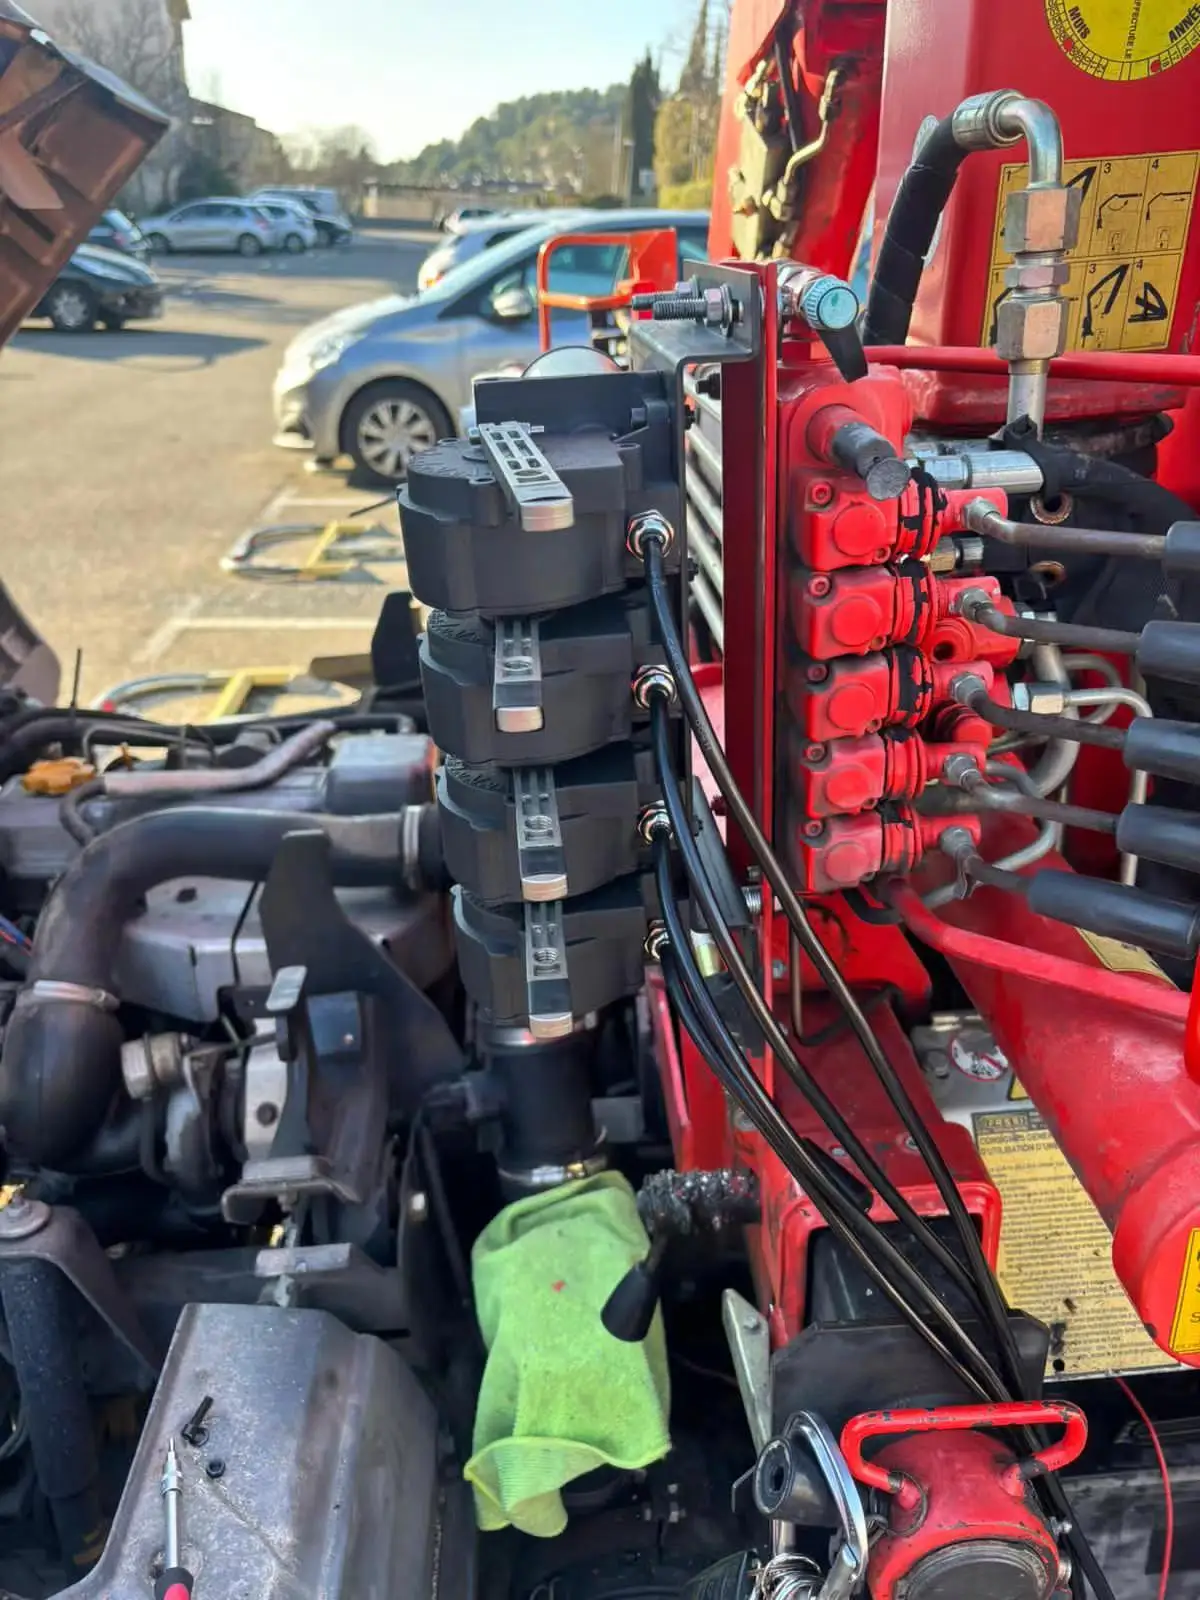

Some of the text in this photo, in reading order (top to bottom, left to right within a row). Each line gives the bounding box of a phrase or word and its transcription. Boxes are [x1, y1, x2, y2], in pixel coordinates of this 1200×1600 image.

[1068, 6, 1090, 39] MOIS
[1103, 162, 1112, 174] 3
[1151, 159, 1159, 169] 4
[1005, 170, 1012, 181] 1
[1089, 263, 1097, 274] 3
[1136, 259, 1144, 270] 4
